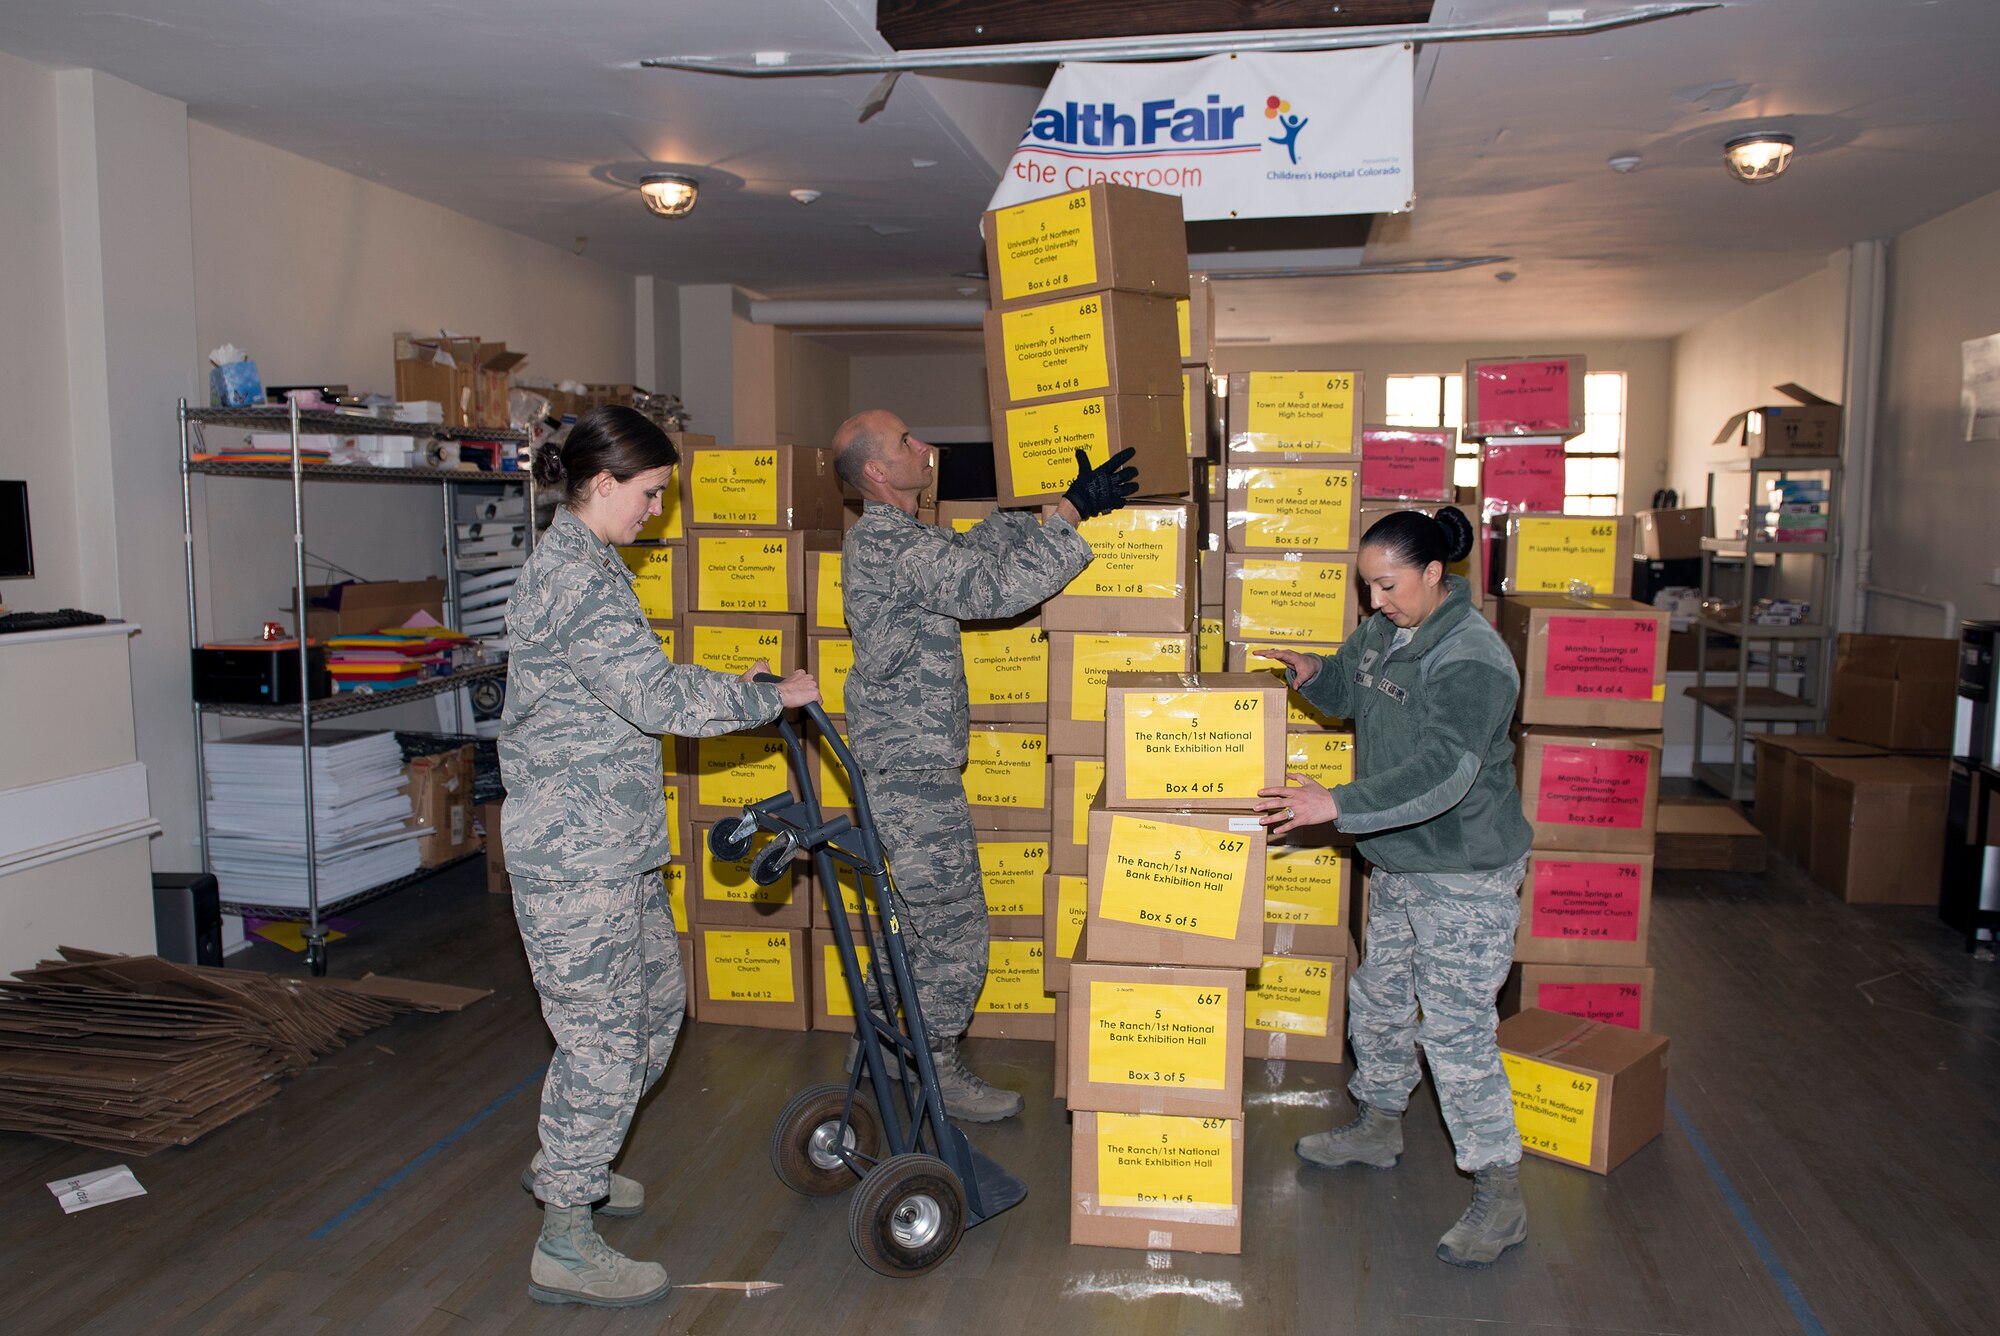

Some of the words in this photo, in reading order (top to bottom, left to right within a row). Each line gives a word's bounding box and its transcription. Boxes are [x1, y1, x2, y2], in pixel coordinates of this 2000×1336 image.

[1013, 160, 1057, 183] the
[1065, 167, 1202, 190] Classroom
[1266, 170, 1312, 181] Children's
[1314, 168, 1355, 180] Hospital
[1357, 166, 1400, 177] Colorado
[1069, 197, 1086, 210] 683
[1041, 222, 1045, 231] 5
[1007, 237, 1039, 249] University
[1041, 233, 1048, 242] of
[1050, 228, 1080, 239] Northern
[1011, 247, 1043, 259] Colorado
[1044, 239, 1078, 252] University
[1034, 255, 1057, 265] Center
[1028, 281, 1043, 290] Box
[1046, 278, 1051, 287] 6
[1053, 275, 1061, 285] of
[1063, 274, 1068, 283] 8
[1080, 303, 1098, 315] 683
[1037, 384, 1053, 392] Box
[1055, 381, 1060, 389] 4
[1062, 379, 1071, 388] of
[1073, 378, 1079, 387] 8
[1327, 379, 1349, 390] 675
[1083, 404, 1101, 415] 683
[1278, 411, 1296, 419] High
[1023, 449, 1056, 458] Colorado
[754, 456, 773, 466] 664
[1047, 457, 1072, 466] Center
[1325, 476, 1347, 487] 675
[1276, 507, 1294, 515] High
[1296, 507, 1321, 515] School
[1275, 536, 1292, 544] Box
[1295, 536, 1300, 544] 5
[1302, 537, 1311, 545] of
[763, 544, 782, 554] 664
[650, 554, 668, 563] 664
[1106, 562, 1134, 570] Center
[1320, 569, 1342, 580] 675
[1096, 584, 1113, 592] Box
[1118, 584, 1121, 592] 1
[1125, 584, 1134, 592] of
[1137, 585, 1143, 593] 8
[721, 600, 735, 608] Box
[737, 600, 746, 608] 12
[748, 600, 755, 608] of
[758, 600, 766, 608] 12
[759, 636, 778, 645] 664
[1161, 644, 1180, 654] 683
[1234, 699, 1258, 711] 667
[1192, 718, 1198, 728] 5
[1136, 732, 1152, 740] The
[1156, 732, 1206, 740] Ranch/1st
[1209, 732, 1252, 740] National
[764, 743, 785, 753] 664
[1022, 740, 1042, 750] 669
[1146, 745, 1171, 753] Bank
[1175, 744, 1222, 752] Exhibition
[1226, 744, 1244, 752] Hall
[1166, 783, 1187, 793] Box
[1191, 783, 1198, 792] 4
[1202, 783, 1213, 792] of
[1217, 783, 1224, 792] 5
[977, 794, 992, 802] Box
[994, 795, 1000, 803] 3
[1219, 840, 1243, 852] 667
[1024, 848, 1044, 858] 669
[1174, 850, 1181, 860] 5
[1314, 855, 1336, 866] 675
[1118, 855, 1134, 865] The
[1138, 859, 1187, 873] Ranch/1st
[1190, 867, 1232, 880] National
[1126, 869, 1150, 880] Bank
[1154, 874, 1201, 888] Exhibition
[1204, 882, 1223, 891] Hall
[1267, 884, 1284, 892] High
[1140, 910, 1161, 921] Box
[1165, 914, 1172, 923] 5
[1175, 917, 1187, 926] of
[1190, 918, 1197, 927] 5
[768, 938, 786, 947] 664
[1305, 967, 1327, 978] 675
[1198, 994, 1221, 1005] 667
[1100, 1020, 1116, 1029] The
[1120, 1022, 1169, 1031] Ranch/1st
[1172, 1024, 1214, 1033] National
[1110, 1033, 1134, 1042] Bank
[1138, 1034, 1184, 1044] Exhibition
[1188, 1037, 1206, 1045] Hall
[1129, 1071, 1149, 1080] Box
[1154, 1072, 1160, 1081] 3
[1164, 1072, 1175, 1081] of
[1179, 1073, 1185, 1082] 5
[1572, 1080, 1592, 1092] 667
[1203, 1118, 1226, 1129] 667
[1108, 1145, 1124, 1153] The
[1128, 1146, 1176, 1155] Ranch/1st
[1179, 1148, 1220, 1156] National
[1118, 1157, 1142, 1165] Bank
[1145, 1158, 1191, 1166] Exhibition
